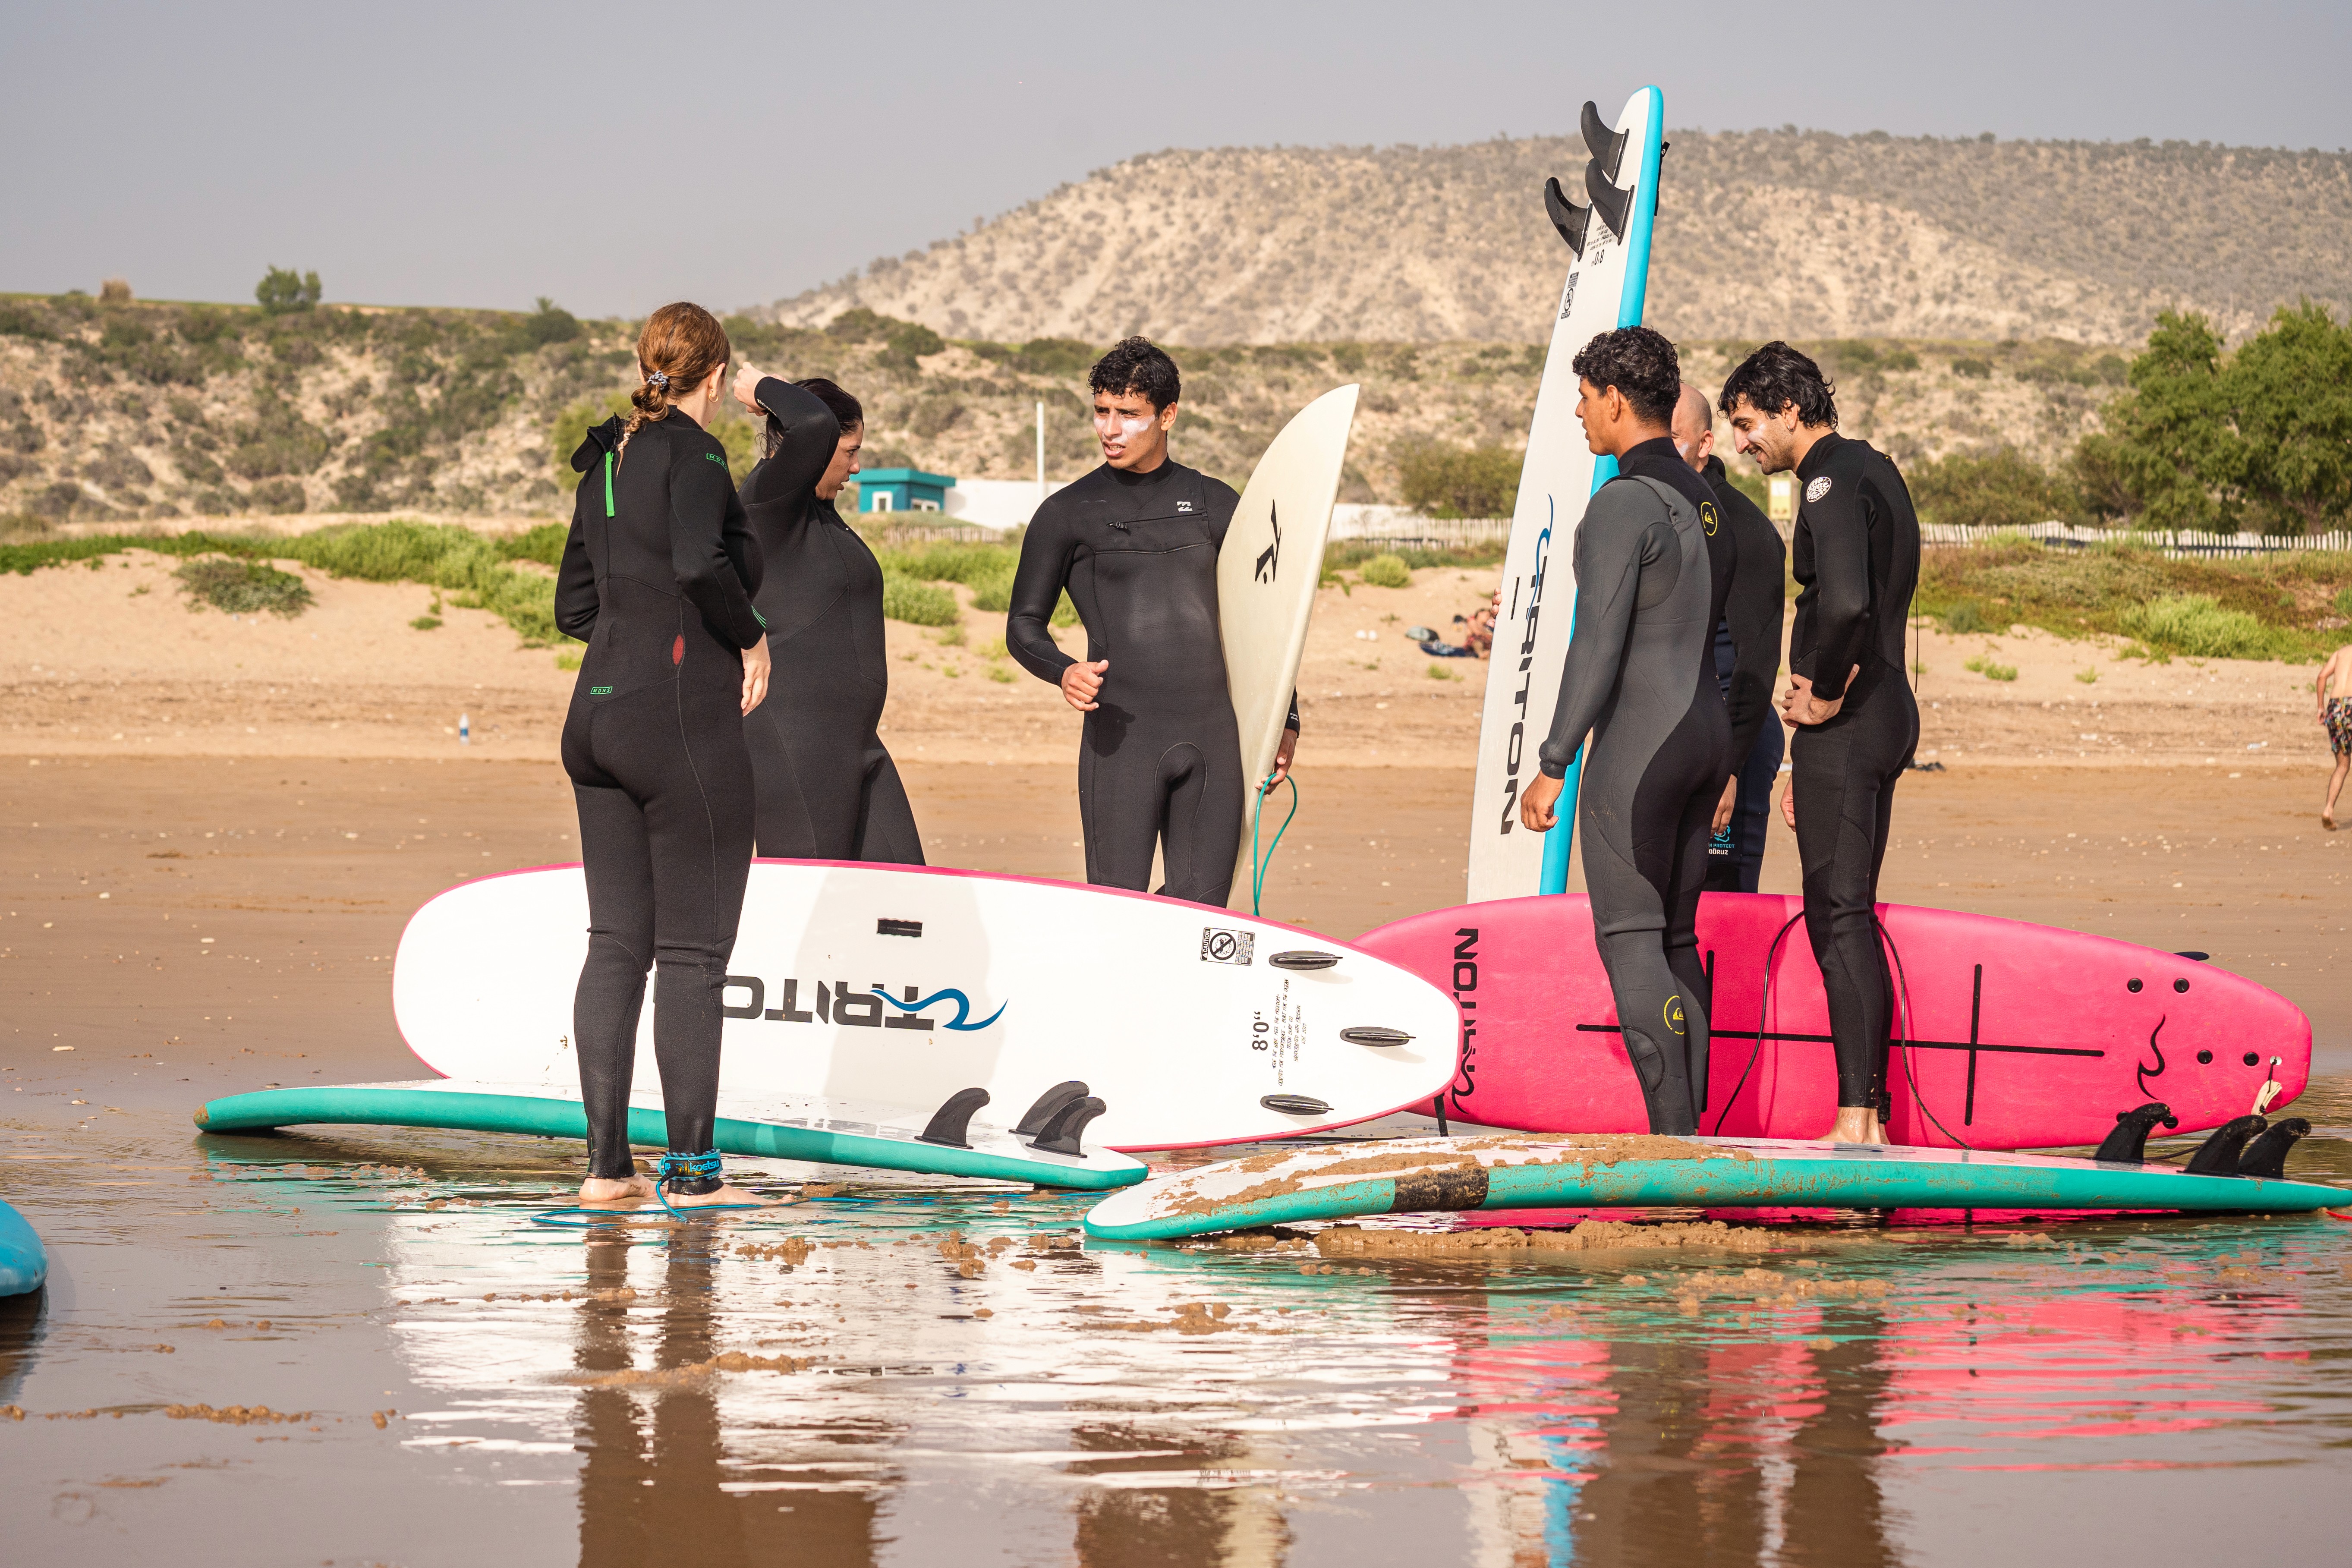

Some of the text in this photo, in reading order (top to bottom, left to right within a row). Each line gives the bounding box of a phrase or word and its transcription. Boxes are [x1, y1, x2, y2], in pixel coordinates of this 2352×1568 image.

[1501, 555, 1548, 835] TRITON
[654, 971, 934, 1031] TRITO
[689, 1160, 720, 1172] koetsu
